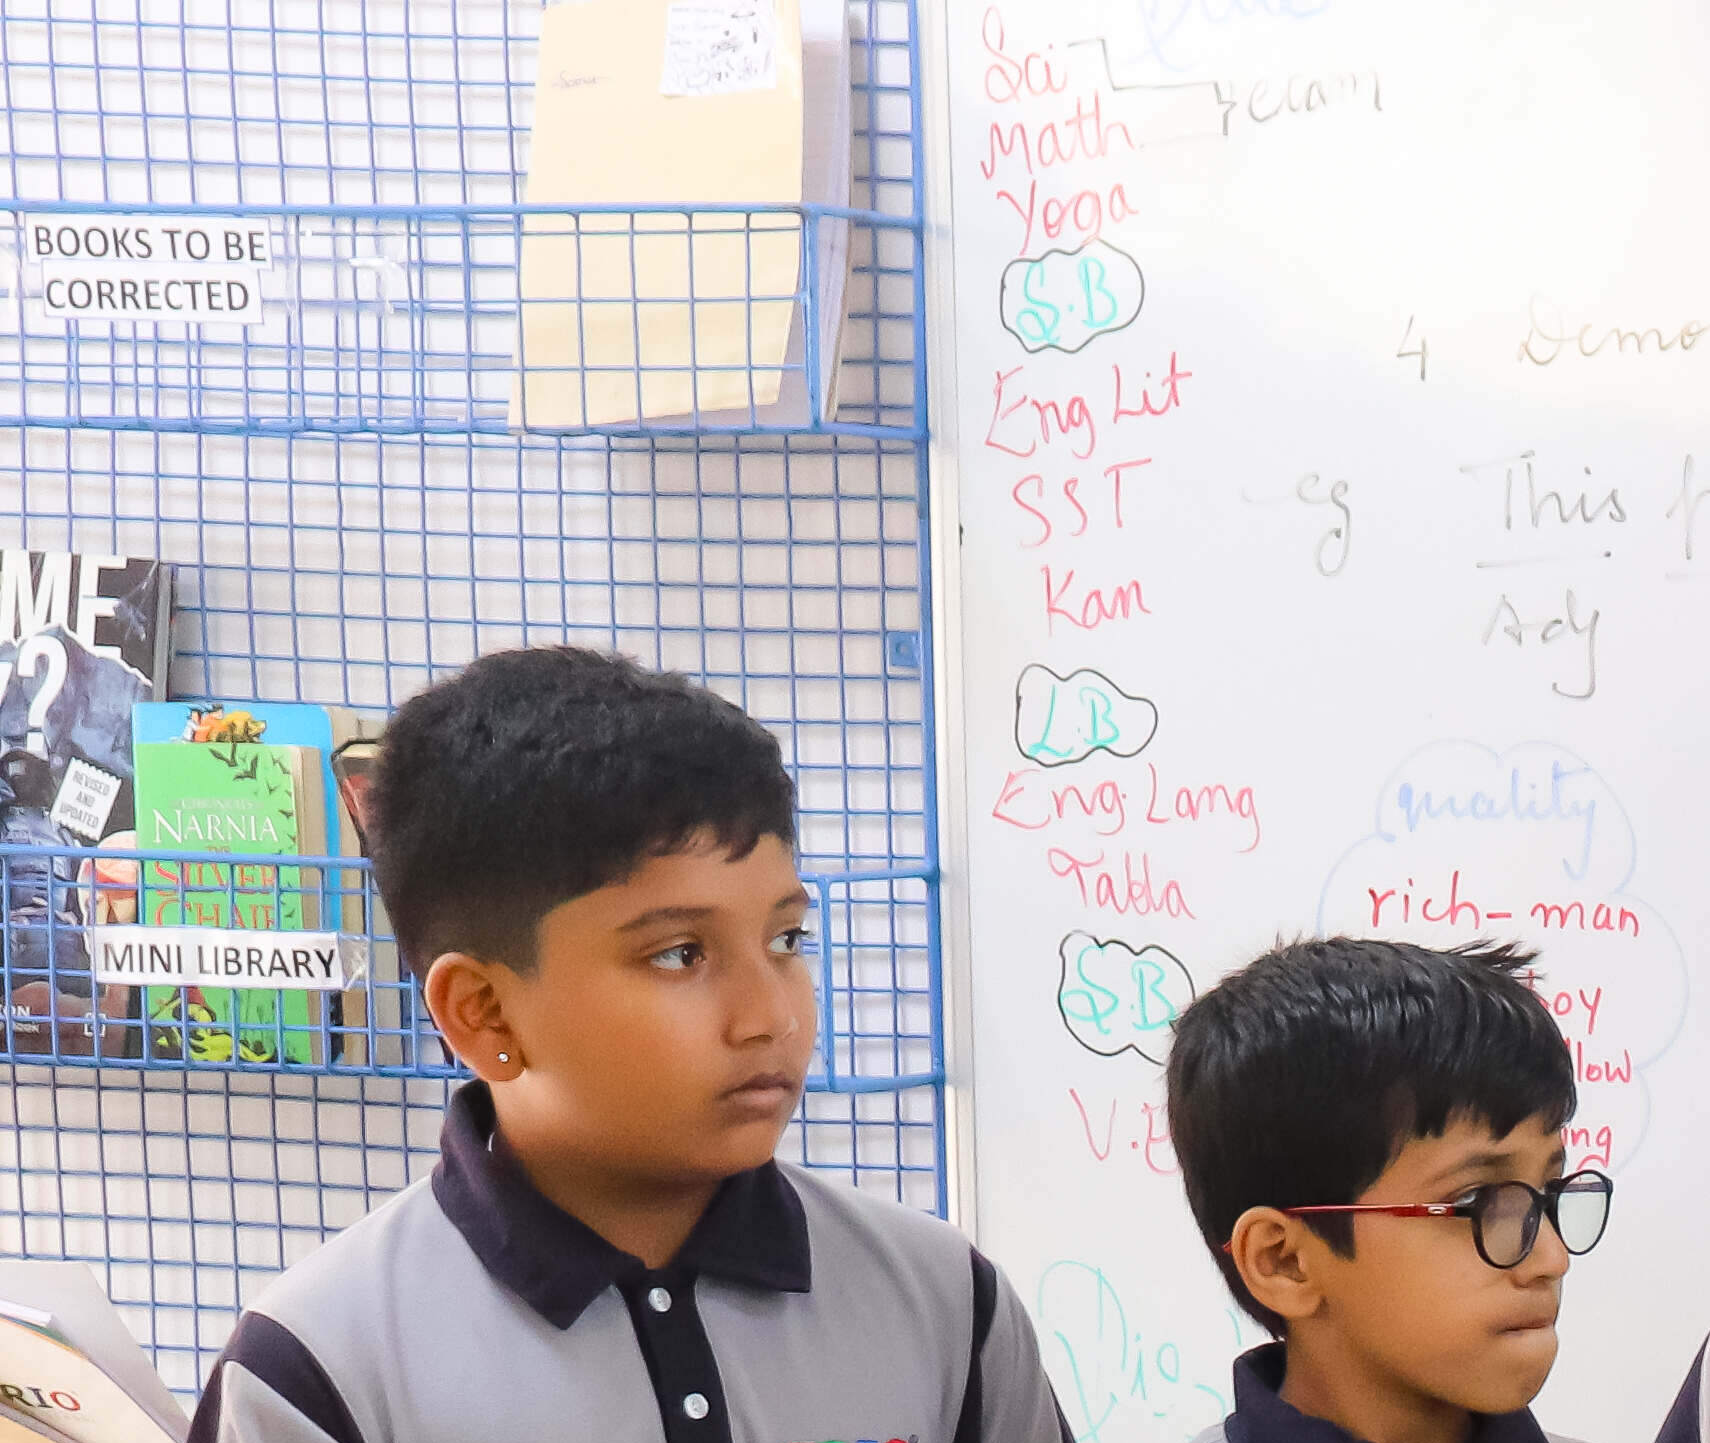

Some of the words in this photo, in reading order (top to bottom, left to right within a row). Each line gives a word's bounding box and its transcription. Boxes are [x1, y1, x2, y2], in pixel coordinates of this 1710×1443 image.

[982, 6, 1067, 104] Sci
[981, 88, 1136, 181] Math
[34, 225, 153, 259] BOOKS
[162, 228, 210, 260] TO
[223, 229, 268, 262] BE
[996, 178, 1139, 257] Yoga
[46, 278, 249, 312] CORRECTED
[985, 365, 1097, 460] Eng
[1112, 351, 1193, 425] Lit
[1459, 450, 1628, 531] This
[1040, 563, 1153, 638] Kan
[152, 808, 279, 844] NARNIA
[1145, 762, 1261, 854] Lang
[1397, 759, 1598, 881] quality
[1047, 847, 1197, 920] Tabla
[101, 941, 185, 976] MINI
[196, 943, 336, 980] LIBRARY
[0, 1384, 81, 1411] RIO
